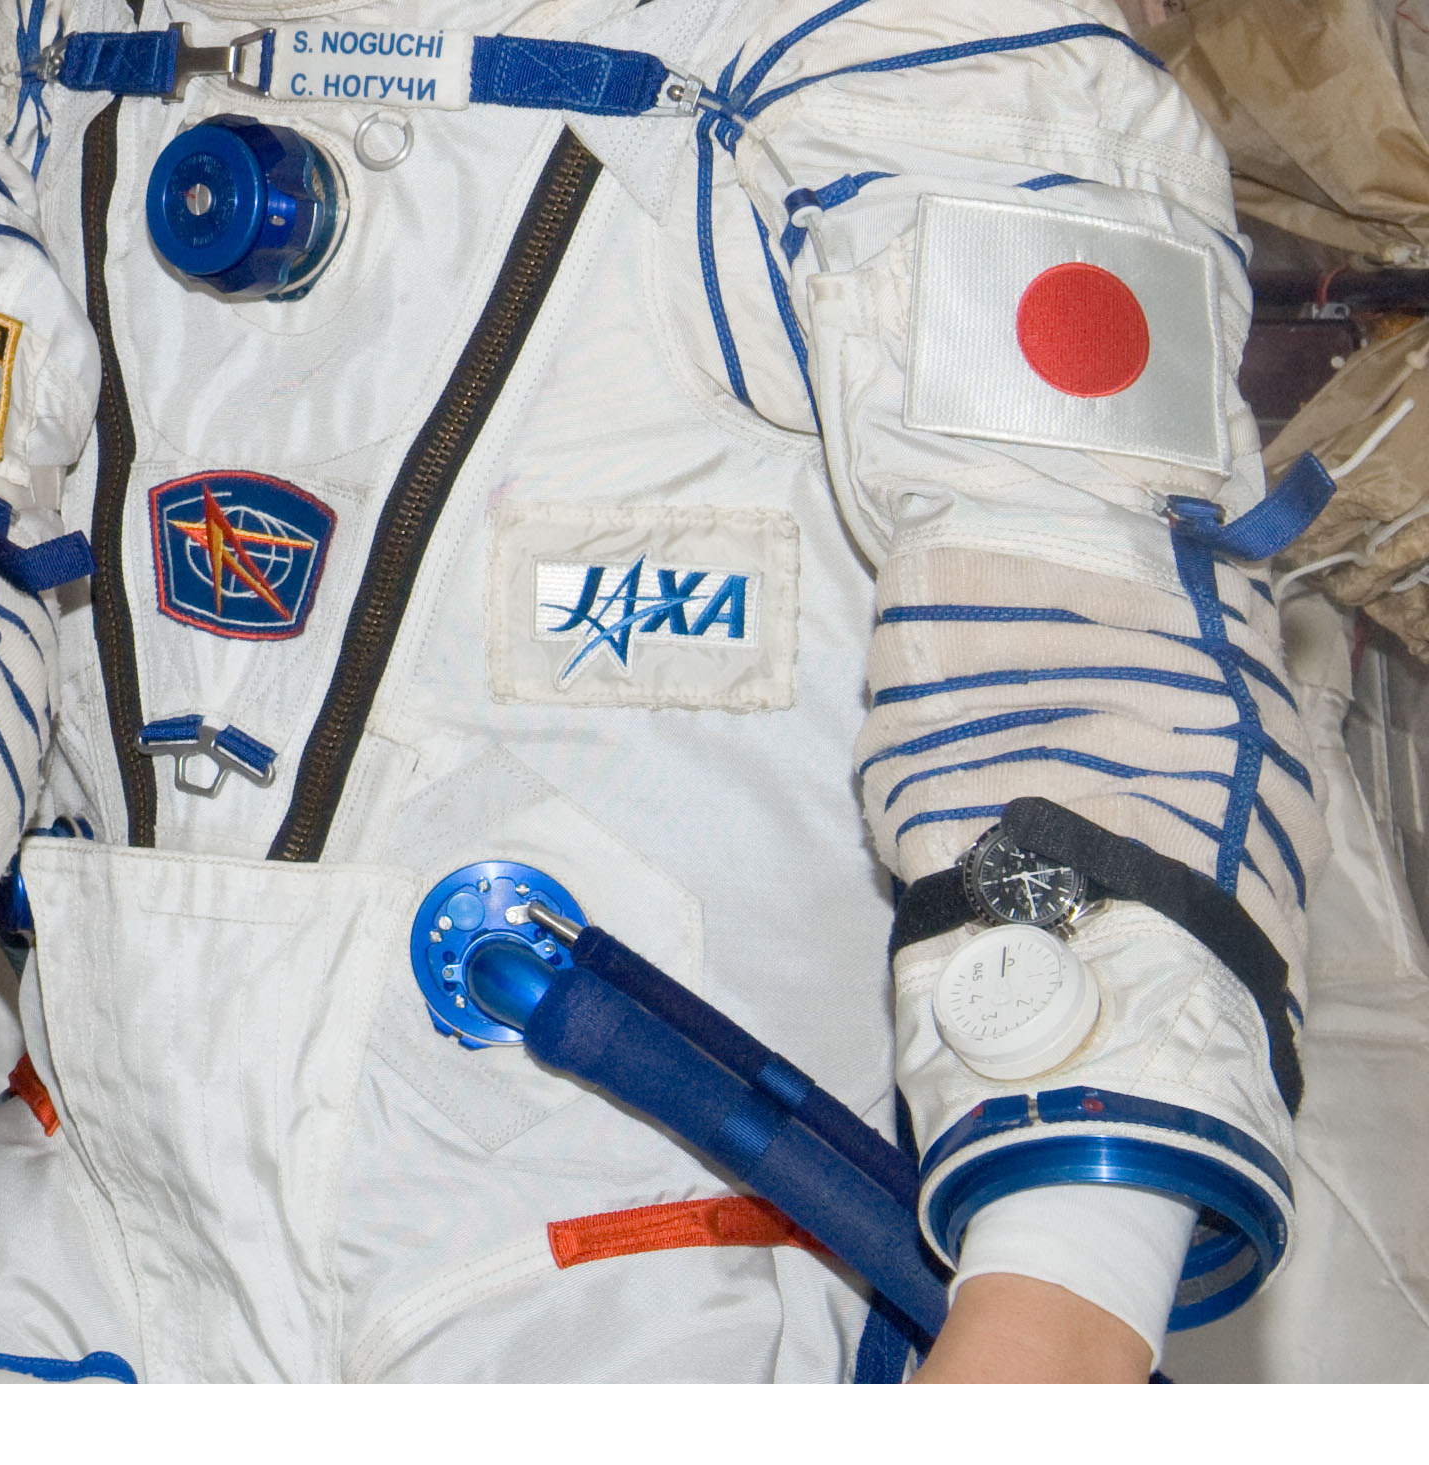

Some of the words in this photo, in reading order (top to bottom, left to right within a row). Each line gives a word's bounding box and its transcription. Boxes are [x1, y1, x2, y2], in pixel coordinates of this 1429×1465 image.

[293, 31, 314, 54] S.
[290, 73, 313, 96] С.
[323, 74, 436, 101] НОГУЧИ
[541, 553, 749, 672] JAXA
